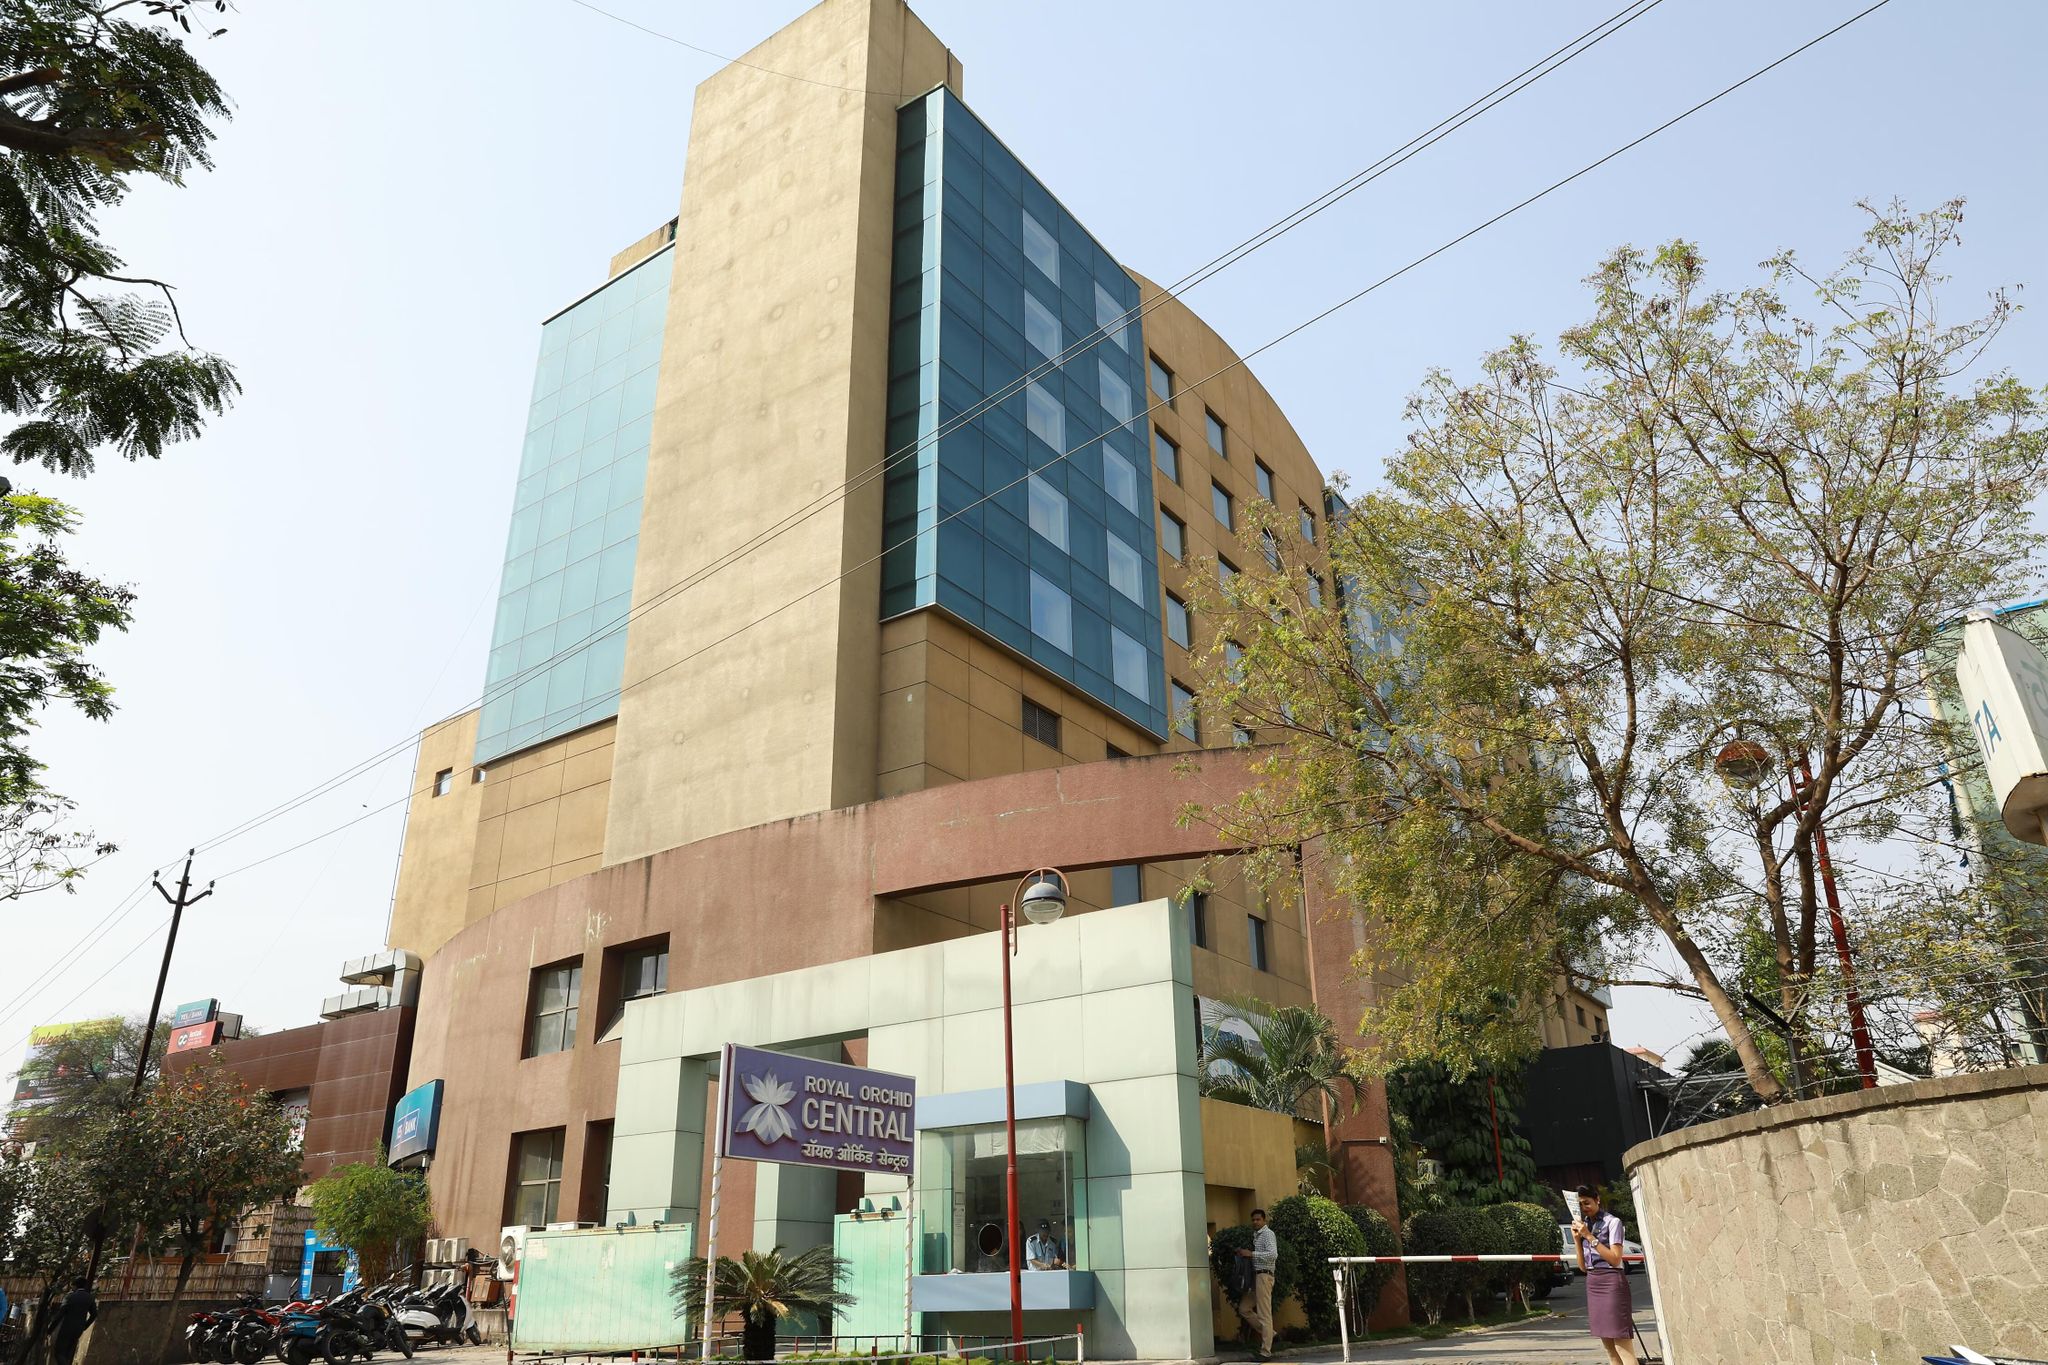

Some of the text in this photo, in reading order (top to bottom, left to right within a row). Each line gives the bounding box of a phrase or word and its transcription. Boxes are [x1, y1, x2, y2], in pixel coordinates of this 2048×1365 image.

[805, 1075, 913, 1108] ROYAL ORCHID
[404, 1116, 417, 1135] BANK
[802, 1098, 913, 1143] CENTRAL
[801, 1138, 834, 1159] रॉयल
[876, 1147, 910, 1172] सेन्ट्रल
